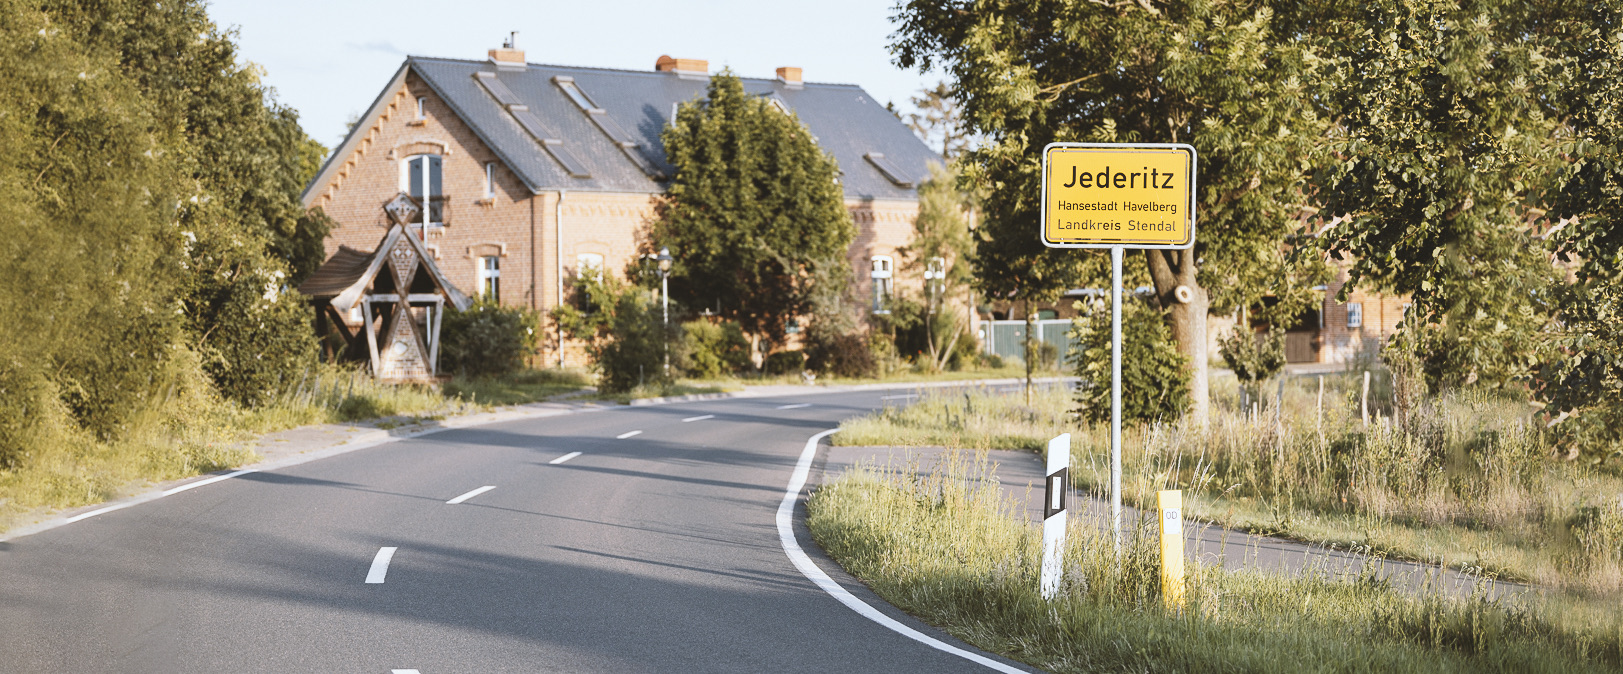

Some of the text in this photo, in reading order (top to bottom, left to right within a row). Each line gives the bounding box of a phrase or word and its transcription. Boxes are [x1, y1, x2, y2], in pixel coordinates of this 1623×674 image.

[1063, 165, 1174, 189] Jederitz
[1058, 200, 1177, 214] Hansestadt Havelberg
[1058, 219, 1176, 232] Landkreis Stendal
